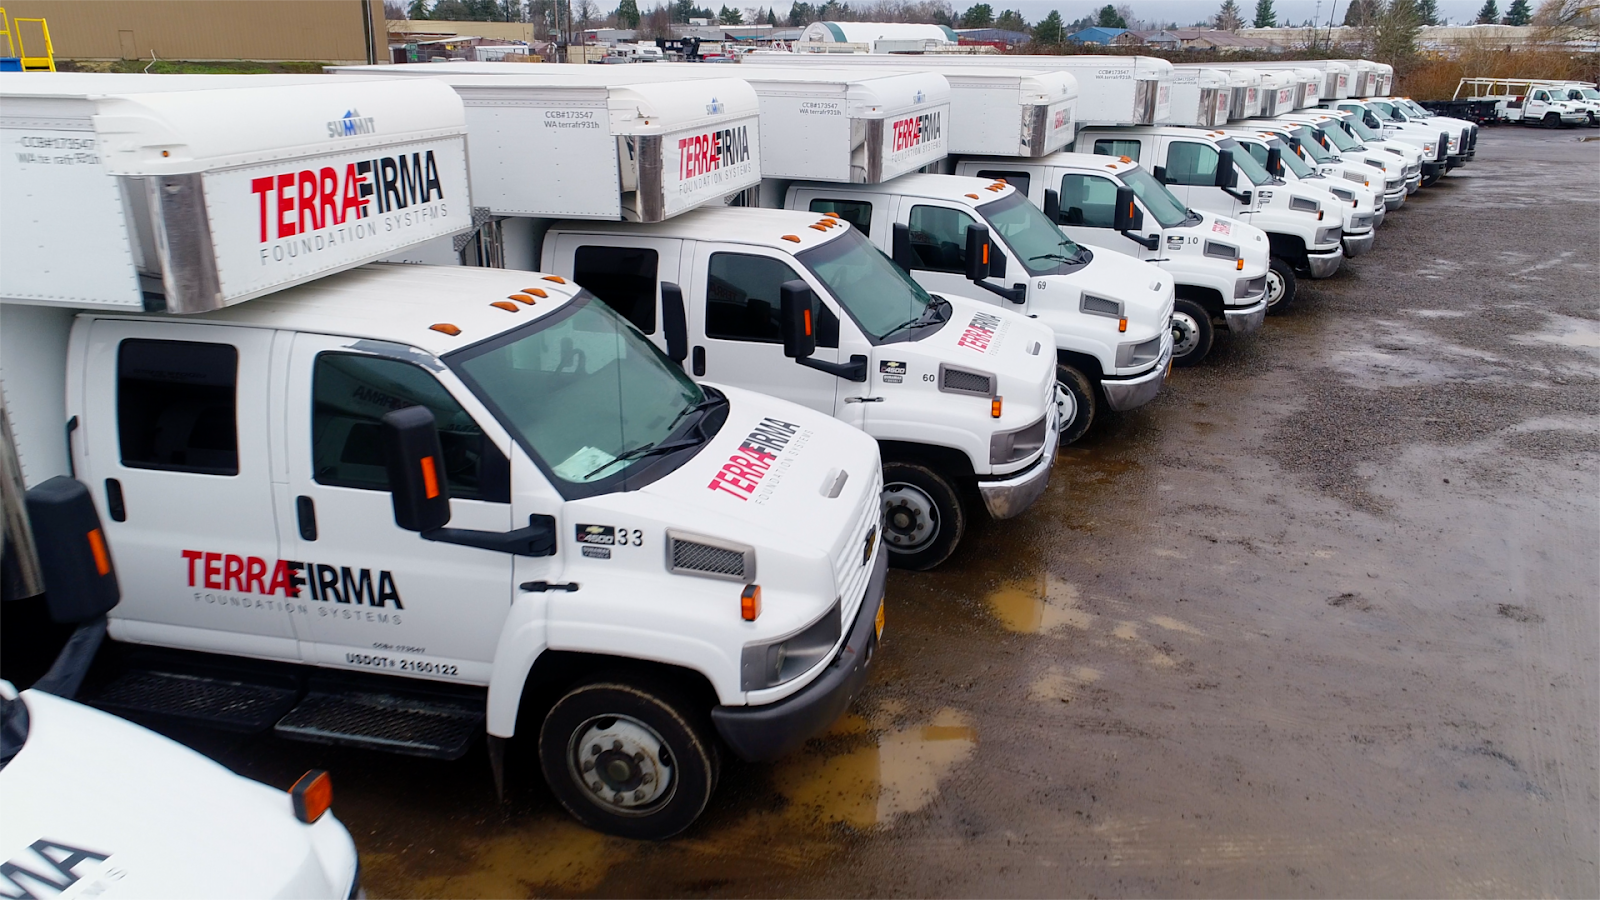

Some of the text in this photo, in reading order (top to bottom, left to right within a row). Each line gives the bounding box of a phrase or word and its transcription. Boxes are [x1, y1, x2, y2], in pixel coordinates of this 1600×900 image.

[327, 117, 376, 138] SUMMIT
[679, 163, 751, 195] FOUNDATION SYSTEMS
[261, 203, 448, 266] FOUNDATION SYSTEMS
[1037, 280, 1046, 290] 69
[922, 373, 935, 382] 60
[755, 429, 814, 505] FOUNDATION SYSTEMS
[618, 528, 643, 547] 33
[193, 592, 403, 626] FOUNDATION SYSTEMS
[345, 652, 459, 676] USDOT# 2160122
